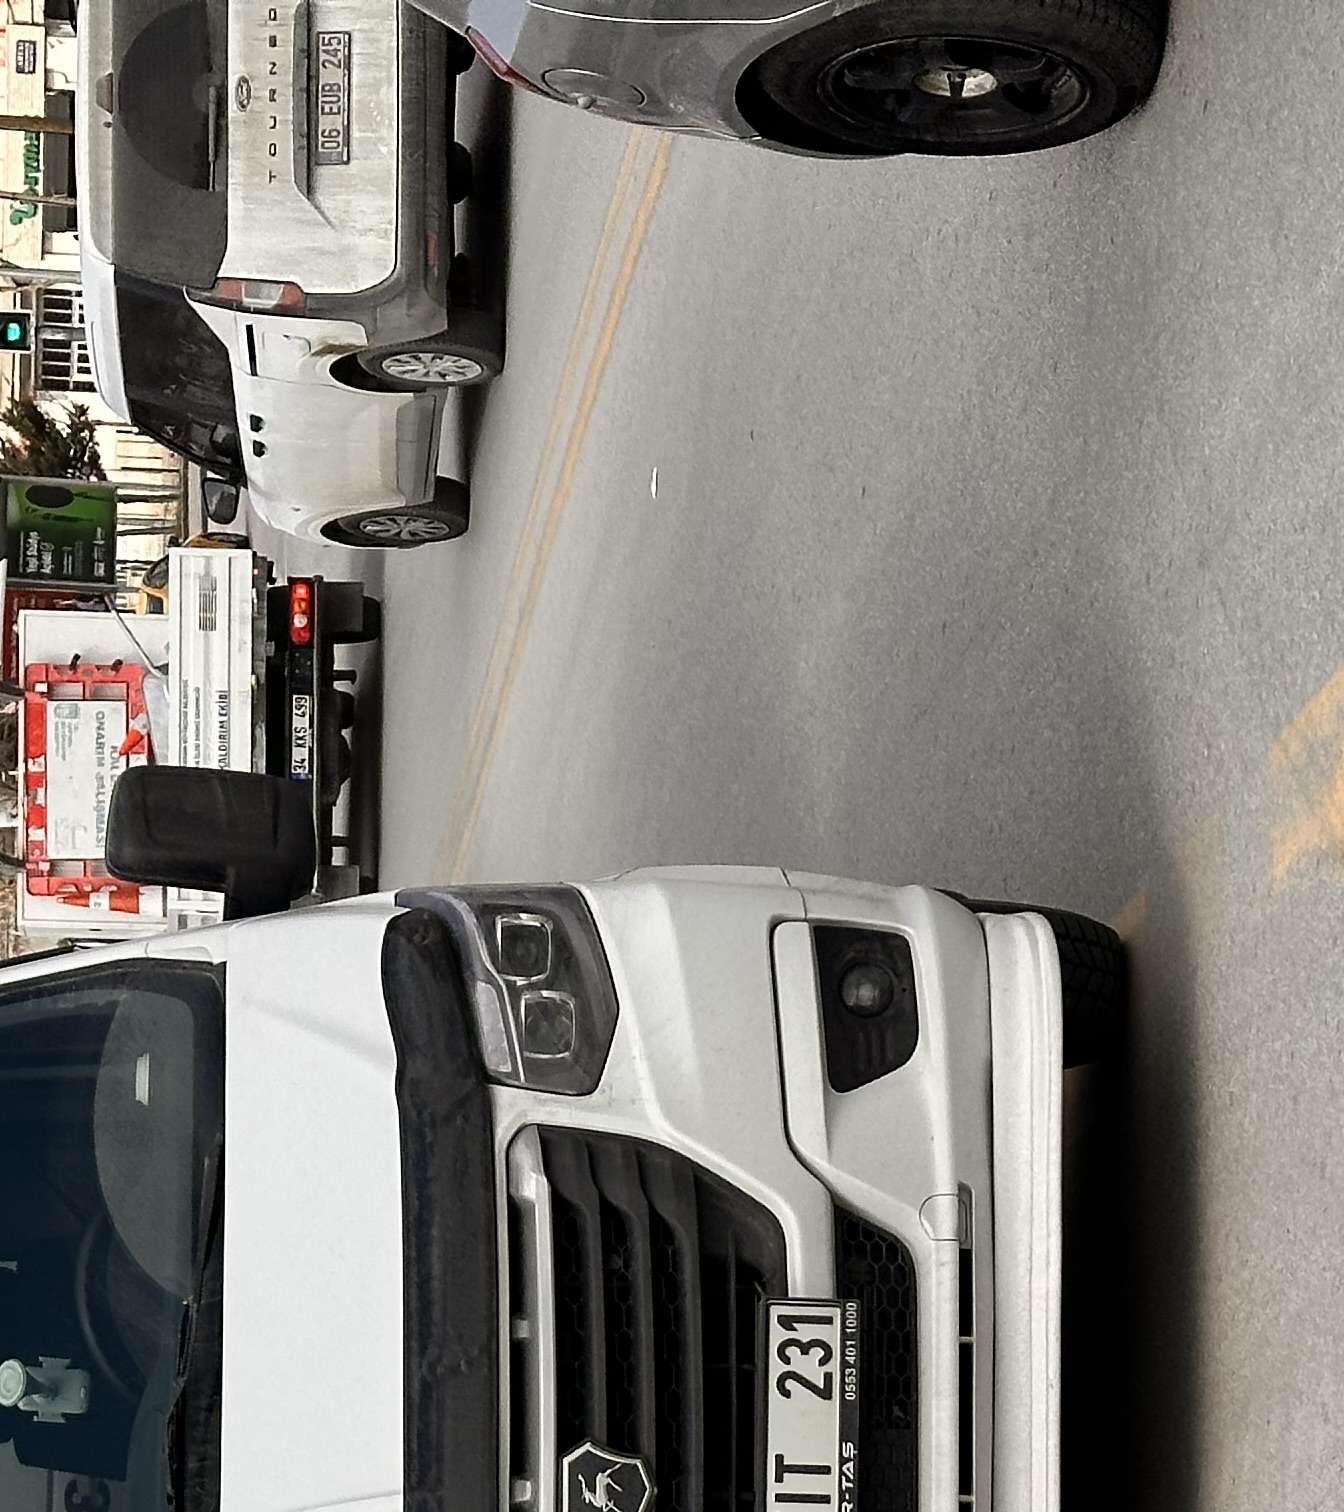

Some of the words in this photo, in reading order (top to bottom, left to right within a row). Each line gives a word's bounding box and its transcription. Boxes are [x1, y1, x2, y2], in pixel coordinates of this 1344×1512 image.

[321, 35, 342, 70] 245
[320, 82, 342, 116] EUB
[320, 128, 341, 150] 06
[293, 758, 307, 772] 34
[845, 1301, 858, 1334] 1000
[775, 1314, 834, 1401] 231
[845, 1340, 857, 1364] 401
[844, 1368, 857, 1401] 0553
